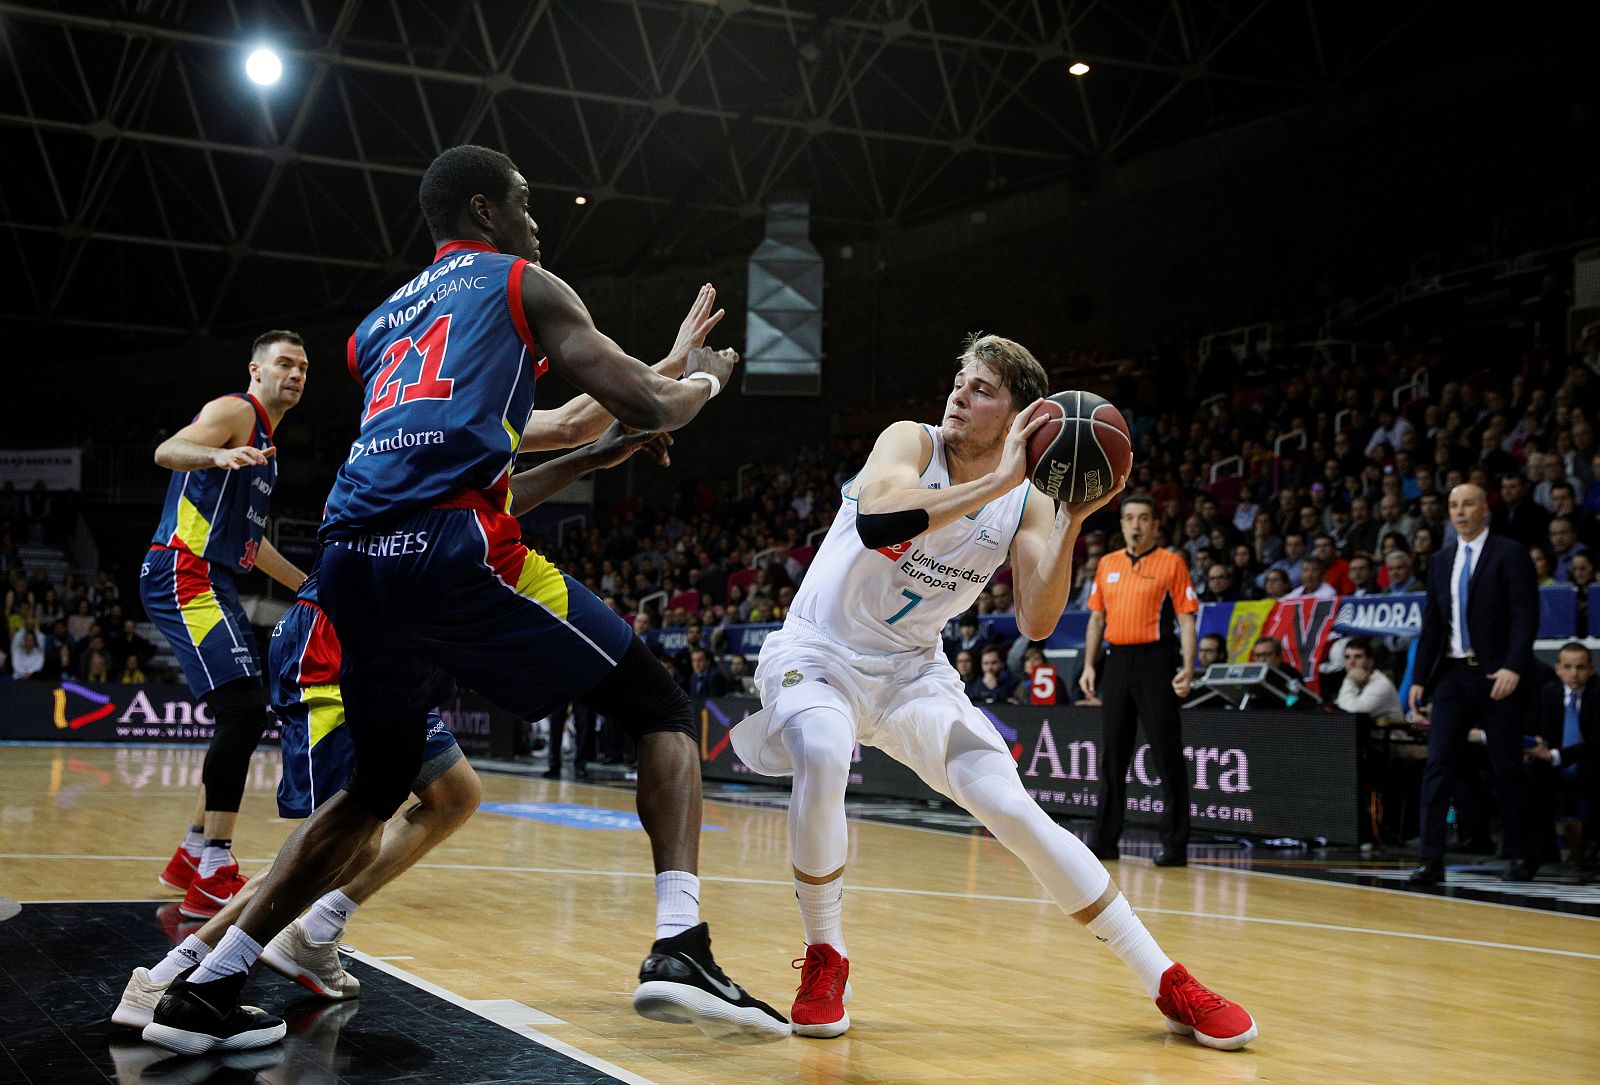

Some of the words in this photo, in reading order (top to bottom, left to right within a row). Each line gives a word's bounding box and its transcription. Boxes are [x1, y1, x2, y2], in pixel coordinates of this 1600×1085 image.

[361, 313, 455, 427] 21
[364, 428, 445, 456] Andorra
[900, 560, 957, 592] Europea
[911, 549, 990, 585] Universidad
[885, 588, 923, 625] 7
[1351, 601, 1423, 629] MORA
[1032, 667, 1055, 699] 5
